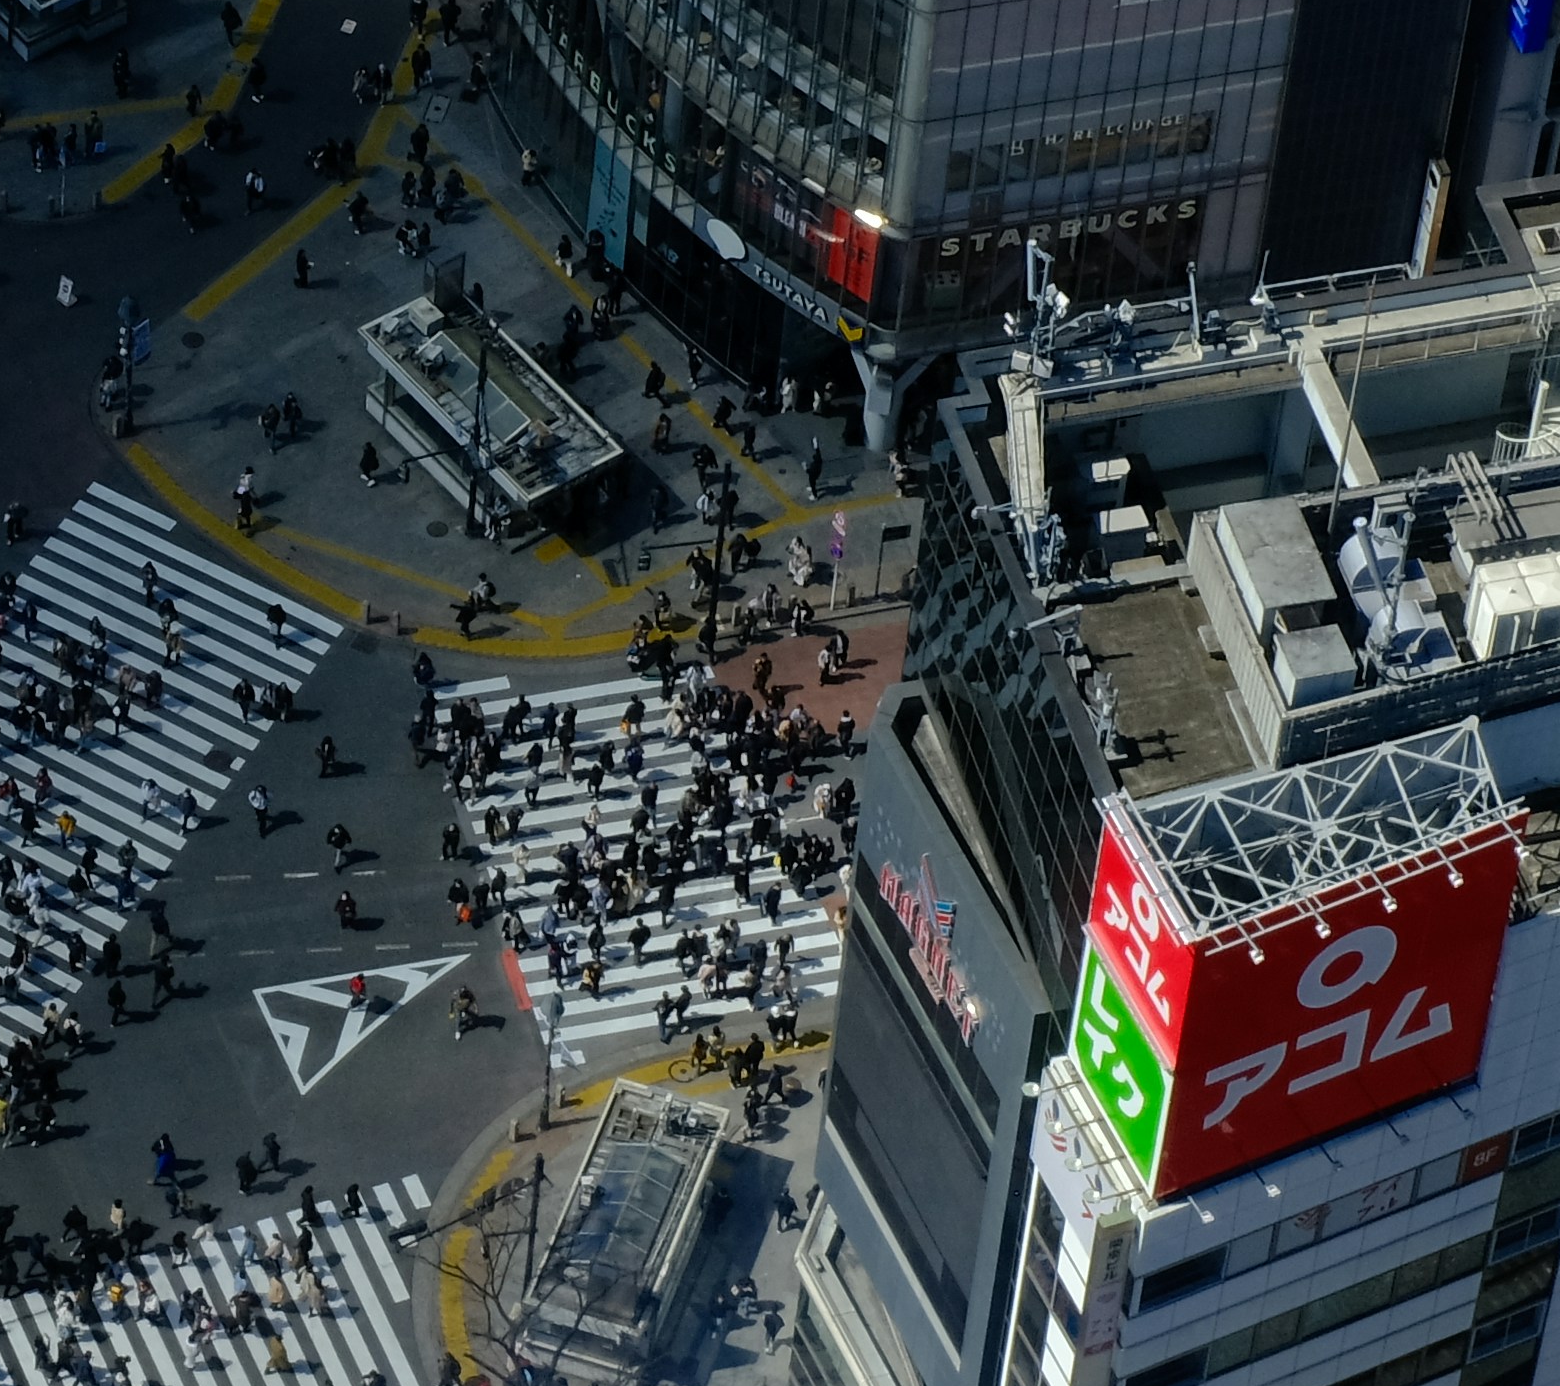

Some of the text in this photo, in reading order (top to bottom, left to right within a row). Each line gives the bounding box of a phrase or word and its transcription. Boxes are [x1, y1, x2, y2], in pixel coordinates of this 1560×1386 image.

[751, 263, 830, 324] TSUTAYA
[940, 199, 1198, 258] STARBUCKS
[1102, 883, 1171, 1026] アコム
[1084, 961, 1146, 1120] レイク
[1202, 985, 1453, 1132] アコム
